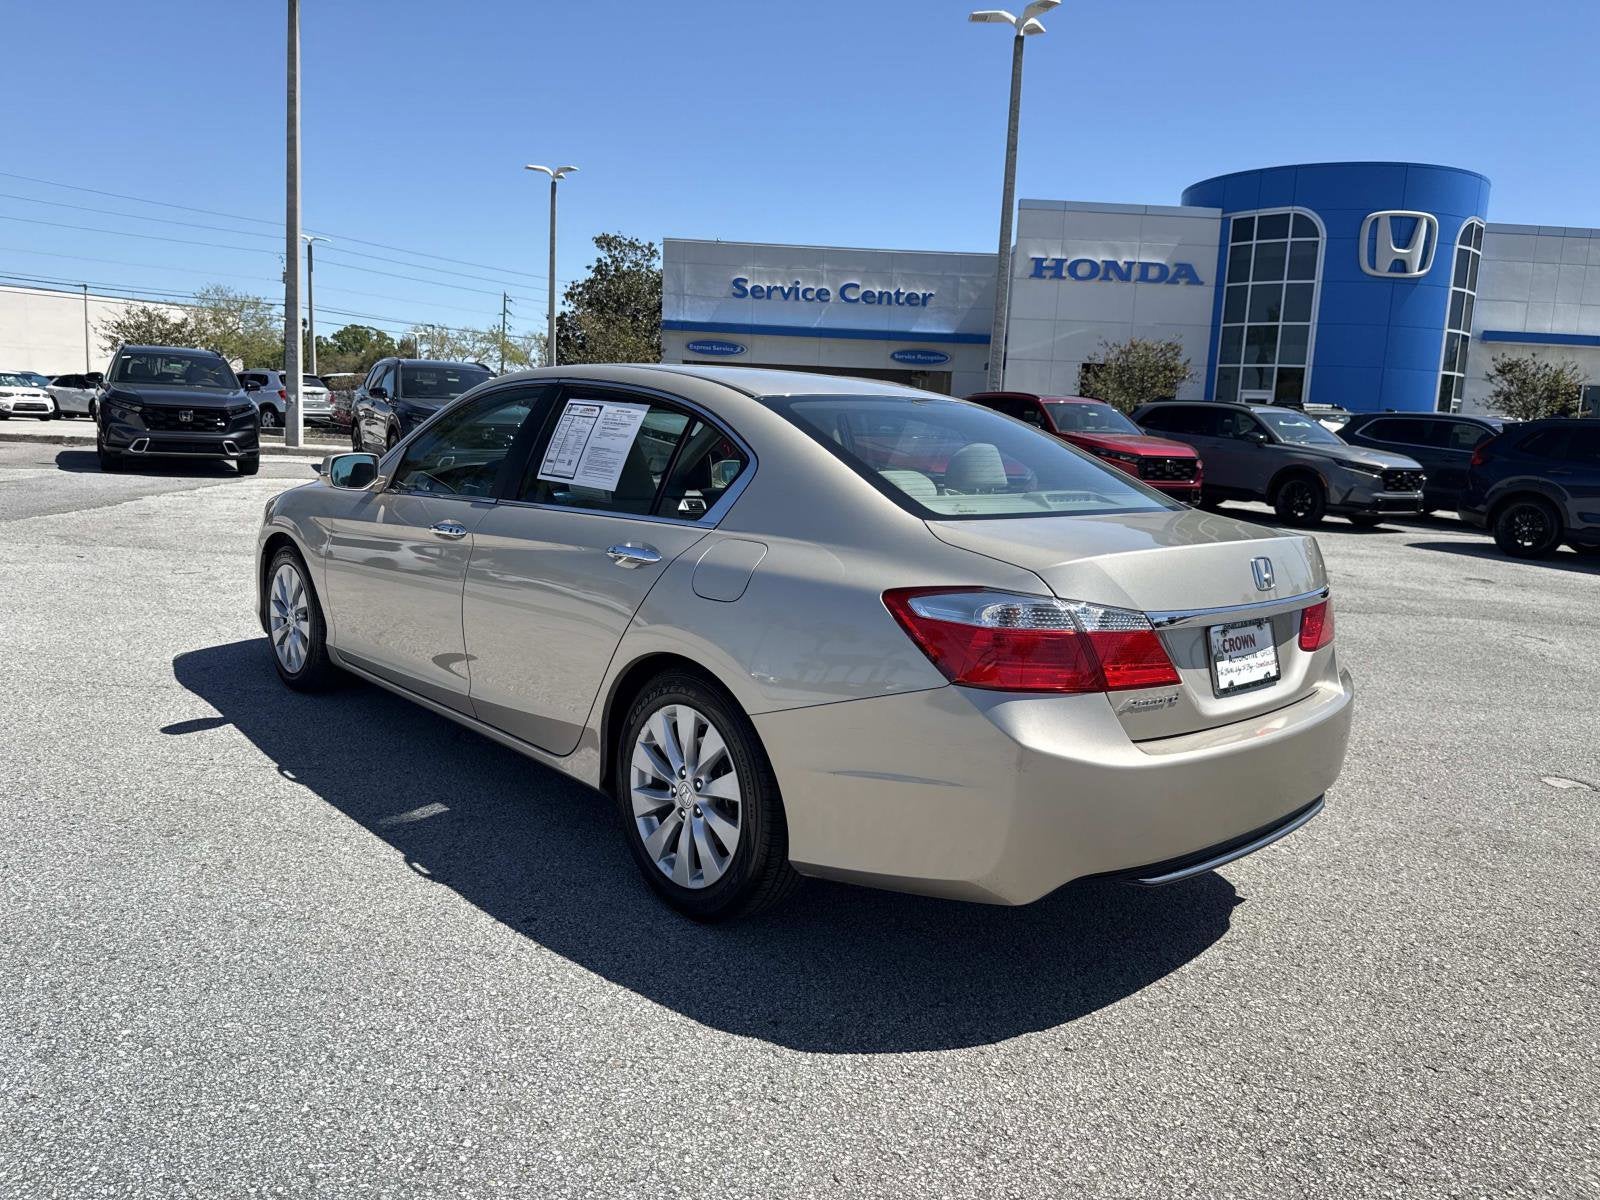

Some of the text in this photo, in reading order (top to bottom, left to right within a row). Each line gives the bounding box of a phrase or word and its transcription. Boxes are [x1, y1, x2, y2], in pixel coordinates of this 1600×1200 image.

[1029, 257, 1204, 286] HONDA
[731, 277, 935, 306] Service Center
[1222, 633, 1257, 653] CROWN
